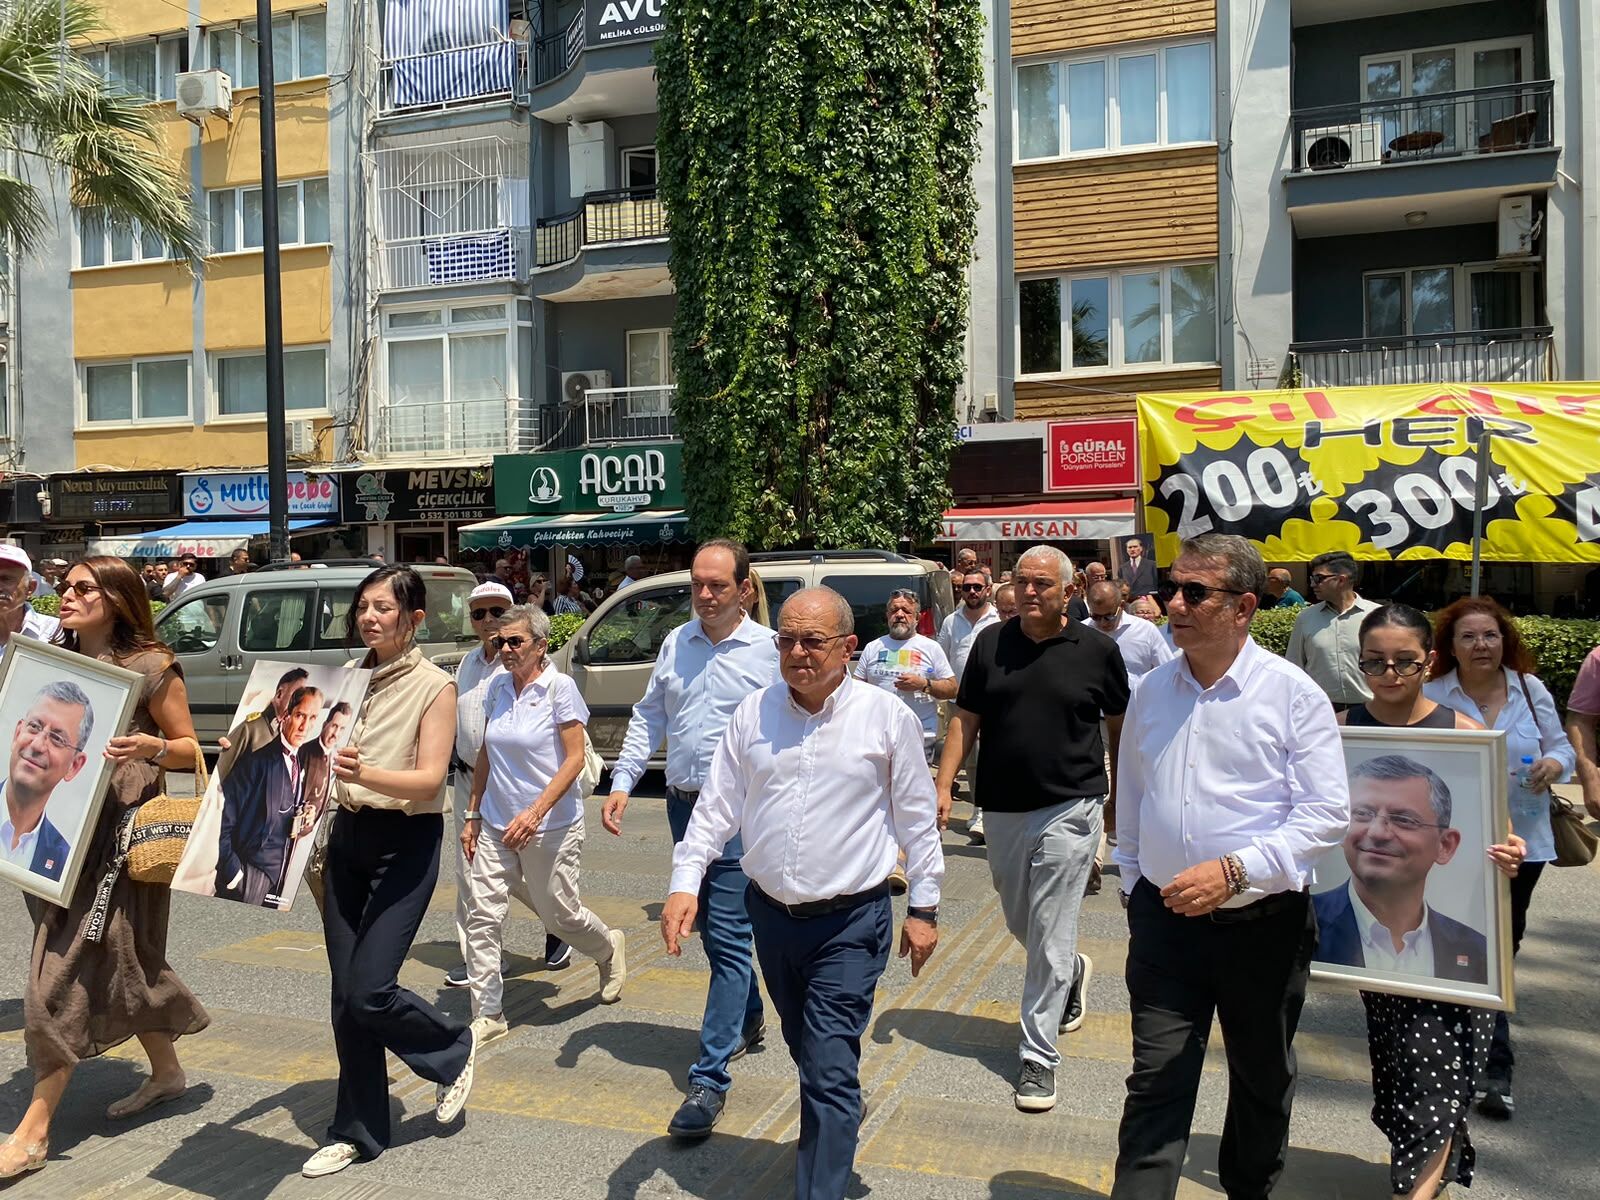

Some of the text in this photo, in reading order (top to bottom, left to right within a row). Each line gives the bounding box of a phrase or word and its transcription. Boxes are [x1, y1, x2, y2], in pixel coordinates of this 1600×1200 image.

[600, 29, 631, 40] MELİHA
[1304, 415, 1540, 448] HER
[1072, 438, 1126, 453] GÜRAL
[1060, 451, 1126, 464] PORSELEN
[579, 450, 666, 495] ACAR
[96, 476, 168, 494] Kuyumculuk
[417, 490, 485, 508] ÇİÇEKÇİLİK
[599, 494, 648, 504] KURUKAHVE
[428, 512, 442, 520] 532
[533, 529, 634, 543] Çekirdekten Kahveciyiz
[1002, 521, 1078, 537] EMSAN
[132, 543, 215, 556] Mutlu bebe
[150, 825, 173, 835] WEST
[97, 886, 109, 909] WEST
[86, 911, 102, 941] COAST
